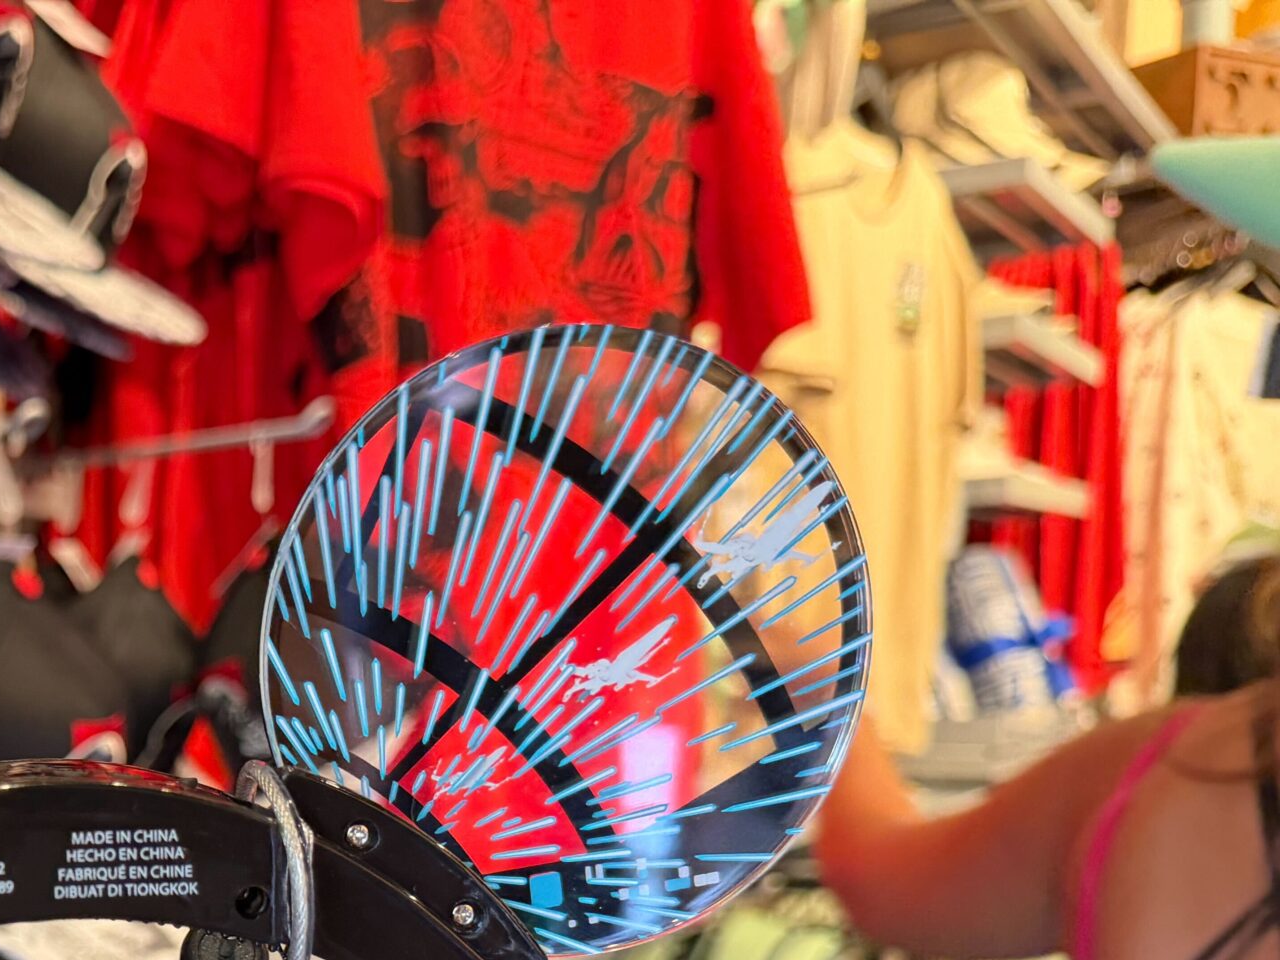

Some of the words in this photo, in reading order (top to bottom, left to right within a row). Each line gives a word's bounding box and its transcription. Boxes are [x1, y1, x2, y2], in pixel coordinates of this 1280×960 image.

[71, 831, 114, 846] MADE
[116, 830, 132, 844] IN
[134, 828, 179, 843] CHINA
[66, 848, 117, 863] HECHO
[119, 847, 138, 861] EN
[140, 846, 185, 861] CHINA
[57, 865, 127, 882] FABRIQUÉ
[129, 866, 148, 880] EN
[150, 864, 193, 879] CHINE
[54, 884, 105, 900] DIBUAT
[107, 883, 123, 898] DI
[124, 881, 199, 897] TIONGKOK
